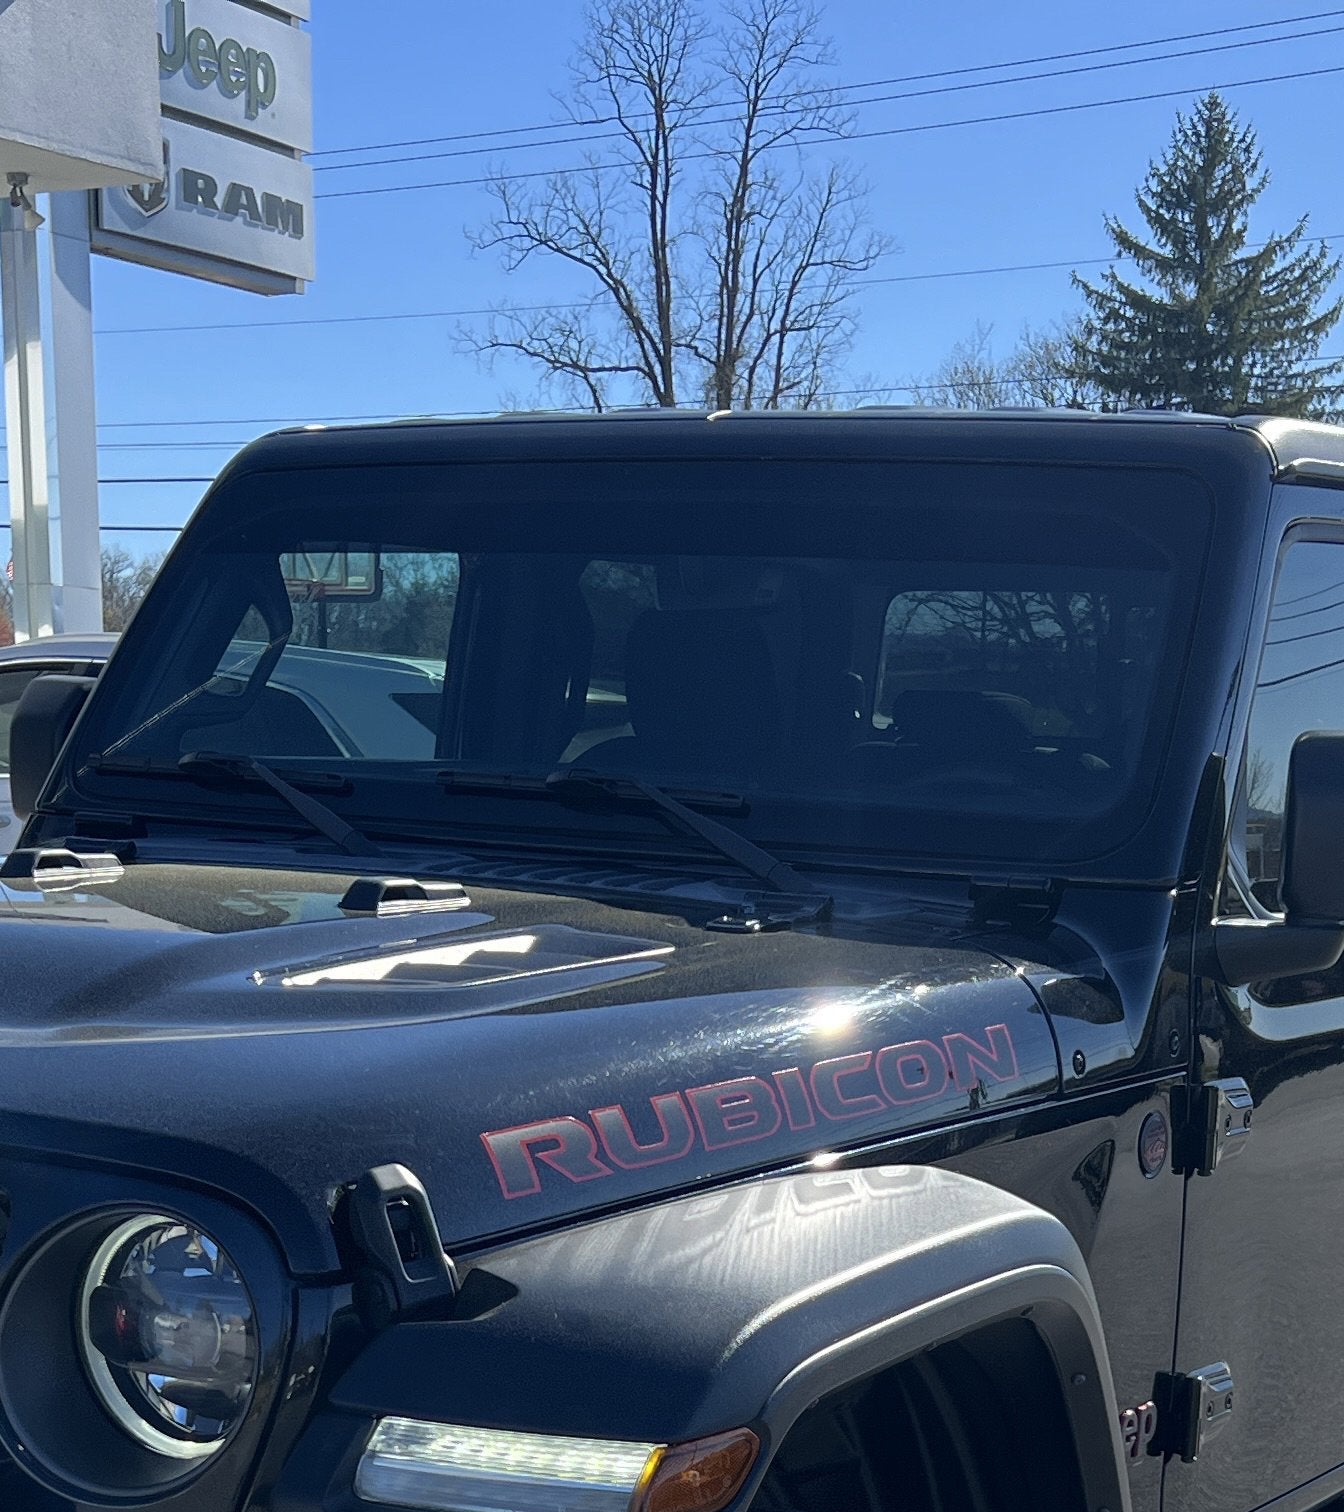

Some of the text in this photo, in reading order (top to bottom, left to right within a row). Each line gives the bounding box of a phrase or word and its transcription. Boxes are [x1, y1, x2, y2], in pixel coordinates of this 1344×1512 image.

[157, 0, 276, 120] Jeep
[175, 168, 304, 240] RAM
[482, 1024, 1021, 1199] RUBICON
[1119, 1401, 1157, 1458] ep
